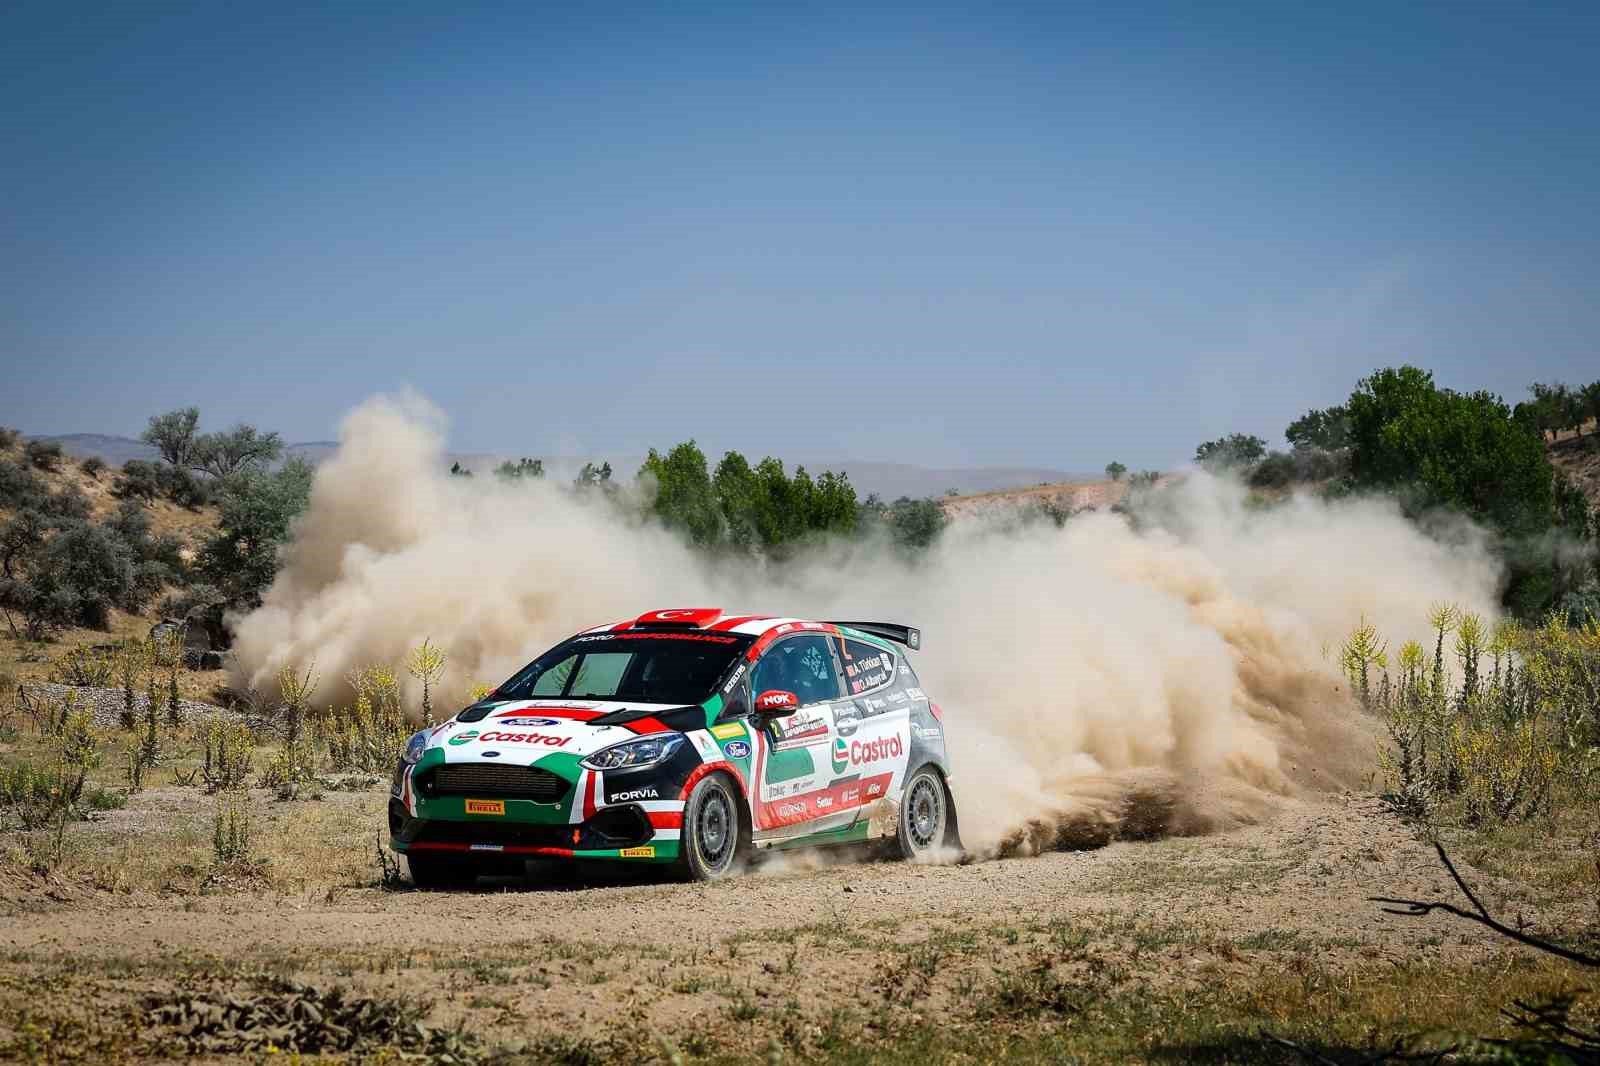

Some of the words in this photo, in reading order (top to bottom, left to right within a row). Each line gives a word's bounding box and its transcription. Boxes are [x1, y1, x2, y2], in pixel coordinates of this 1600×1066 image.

[479, 731, 573, 747] Castrol
[728, 743, 747, 757] Ford
[851, 731, 903, 766] Castrol
[610, 789, 659, 801] FORVIA
[467, 802, 502, 814] PIRELLI
[622, 848, 654, 857] PIRELLI
